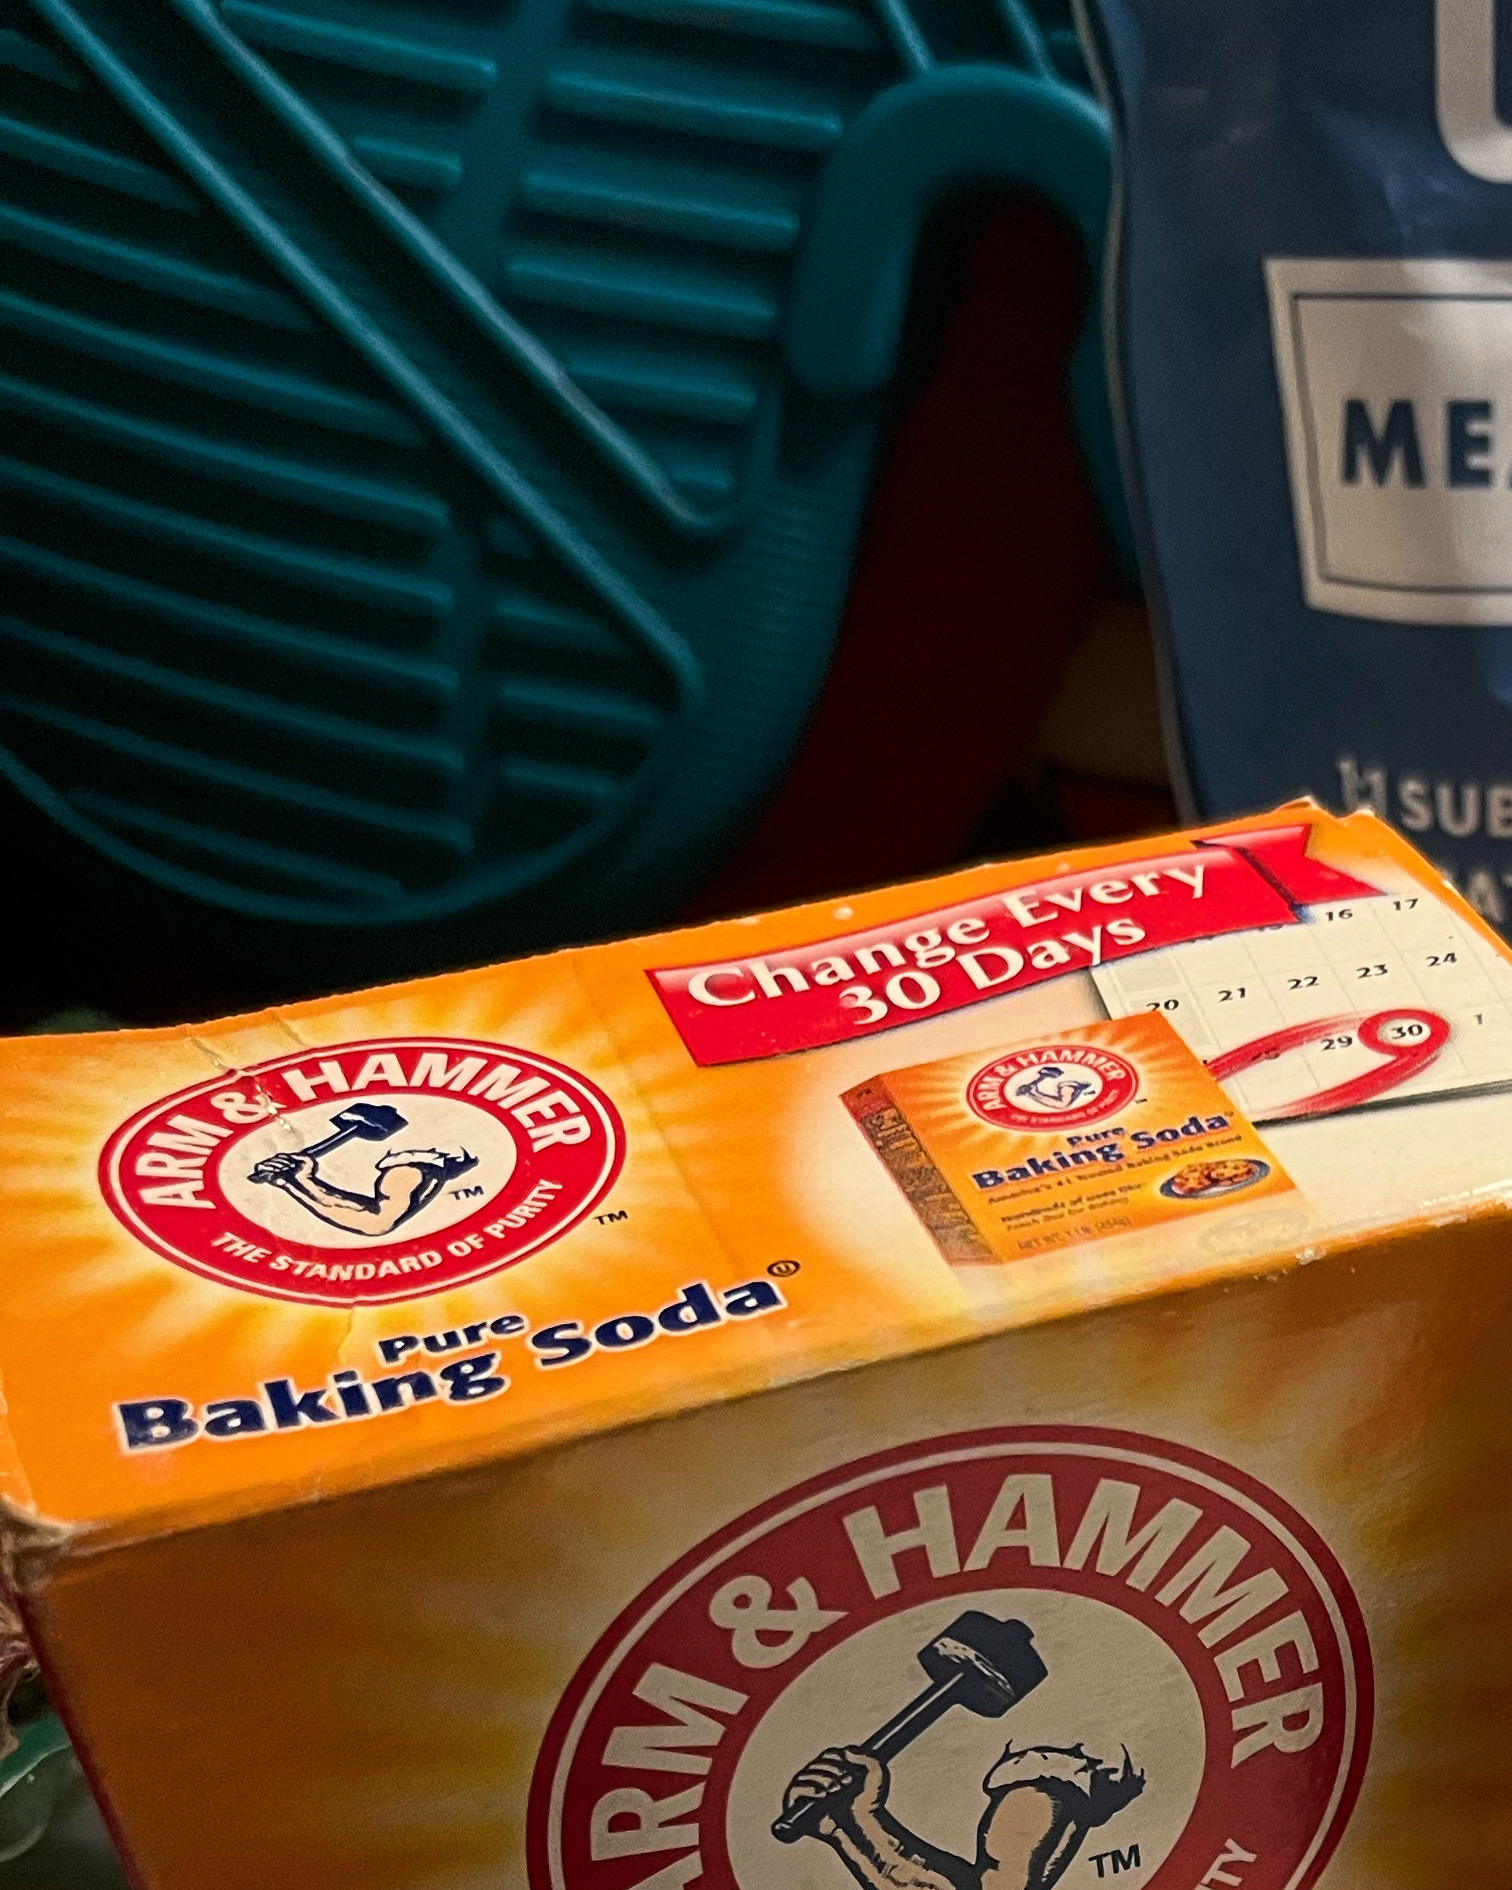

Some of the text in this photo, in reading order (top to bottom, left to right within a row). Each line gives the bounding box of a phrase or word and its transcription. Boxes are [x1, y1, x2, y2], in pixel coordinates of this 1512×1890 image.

[687, 861, 1207, 1009] Change Every
[1325, 898, 1420, 921] 16 17
[840, 917, 1147, 1026] 30 Days
[1147, 952, 1457, 1011] 20 21 22 23 24
[1321, 1035, 1353, 1051] 29
[1391, 1023, 1424, 1038] 30
[977, 1068, 1008, 1112] ARM
[1016, 1050, 1126, 1082] HAMMER
[133, 1052, 592, 1211] ARM & HAMMER
[973, 1115, 1229, 1190] Baking Soda
[1067, 1127, 1125, 1147] Pure
[450, 1185, 484, 1201] TM
[210, 1178, 564, 1283] THE STANDARD OF PURITY
[118, 1280, 785, 1449] Baking Soda
[380, 1313, 528, 1364] Pure
[709, 1572, 848, 1670] &
[843, 1472, 1324, 1769] HAMMER
[1089, 1844, 1142, 1878] TM
